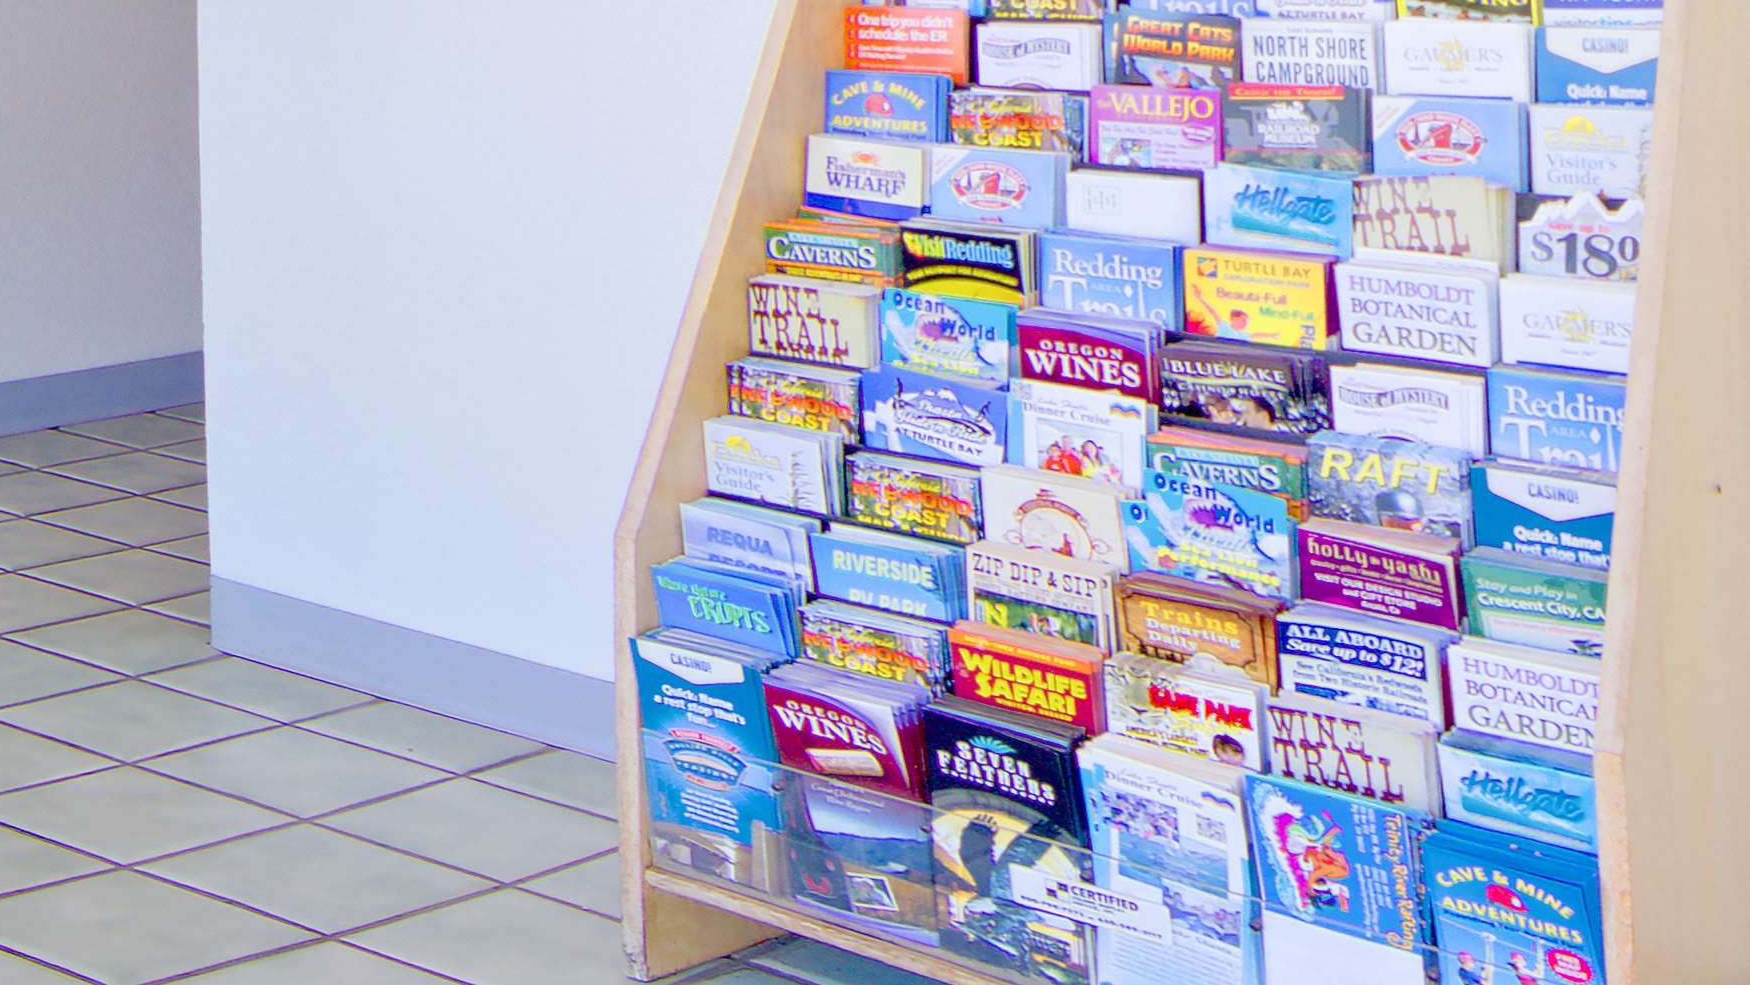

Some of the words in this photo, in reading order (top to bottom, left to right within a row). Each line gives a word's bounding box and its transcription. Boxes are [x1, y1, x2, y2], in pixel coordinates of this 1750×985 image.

[857, 13, 880, 26] One
[1253, 35, 1309, 59] NORTH
[1315, 37, 1367, 61] SHORE
[1256, 61, 1369, 86] CAMPGROUND
[831, 79, 869, 106] CAVE
[873, 79, 885, 94] &
[888, 82, 928, 111] MINE
[1108, 91, 1215, 123] VALLEJO
[1609, 84, 1648, 100] Name
[831, 114, 928, 134] ADVENTURES
[972, 130, 1043, 148] COAST
[1546, 153, 1618, 171] Visitor's
[1546, 169, 1601, 187] Guide
[826, 171, 907, 197] WHARF
[1352, 176, 1434, 216] WINE
[1232, 184, 1336, 225] Hellgate
[1353, 208, 1470, 257] TRAIL
[766, 236, 876, 270] CAVERNS
[944, 237, 1015, 270] Redding
[1053, 247, 1163, 289] Redding
[1223, 259, 1280, 277] TURTLE
[1283, 264, 1312, 278] BAY
[749, 283, 821, 318] WINE
[893, 291, 946, 315] Ocean
[1215, 286, 1287, 306] Beauti-Full
[1348, 275, 1476, 306] HUMBOLDT
[1350, 297, 1478, 329] BOTANICAL
[753, 311, 849, 358] TRAIL
[941, 317, 996, 342] World
[1352, 322, 1477, 357] GARDEN
[1038, 338, 1123, 361] OREGON
[1025, 348, 1141, 388] WINES
[1170, 359, 1226, 377] BLUE
[761, 406, 831, 432] COAST
[1023, 401, 1066, 417] Dinner
[1504, 384, 1626, 429] Redding
[911, 432, 955, 451] TURTLE
[958, 442, 984, 458] BAY
[715, 473, 763, 493] Guide
[1153, 452, 1282, 491] CAVERNS
[1153, 472, 1218, 500] Ocean
[1319, 447, 1451, 495] RAFT
[874, 502, 949, 529] COAST
[1213, 502, 1276, 534] World
[706, 526, 774, 557] REQUA
[1559, 531, 1603, 550] Name
[832, 549, 935, 587] RIVERSIDE
[972, 552, 1004, 577] ZIP
[1009, 561, 1042, 585] DIP
[1047, 571, 1058, 588] &
[1062, 574, 1097, 597] SIP
[1476, 577, 1507, 596] Stay
[1534, 584, 1563, 603] Play
[1140, 600, 1239, 635] Trains
[1477, 592, 1547, 616] Crescent
[1548, 600, 1582, 622] City,
[1585, 606, 1607, 621] CA
[1145, 618, 1243, 650] Departing
[1286, 624, 1332, 643] ALL
[1337, 630, 1424, 660] ABOARD
[828, 653, 907, 681] COAST
[958, 647, 1088, 700] WILDLIFE
[1286, 638, 1329, 659] Save
[1332, 645, 1357, 664] up
[1359, 647, 1377, 663] to
[1380, 650, 1426, 679] $12!
[1462, 656, 1598, 698] HUMBOLDT
[699, 692, 734, 711] Name
[974, 672, 1078, 716] SAFARI
[772, 704, 888, 756] WINES
[784, 699, 868, 731] OREGON
[1269, 706, 1365, 755] WINE
[936, 748, 1057, 801] FEATHERS
[953, 740, 1031, 779] SEVEN
[1272, 736, 1404, 804] TRAIL
[1070, 886, 1139, 912] CERTIFIED
[1435, 866, 1488, 888] CAVE
[1491, 869, 1510, 885] &
[1515, 876, 1576, 919] MINE
[1440, 896, 1584, 944] ADVENTURES
